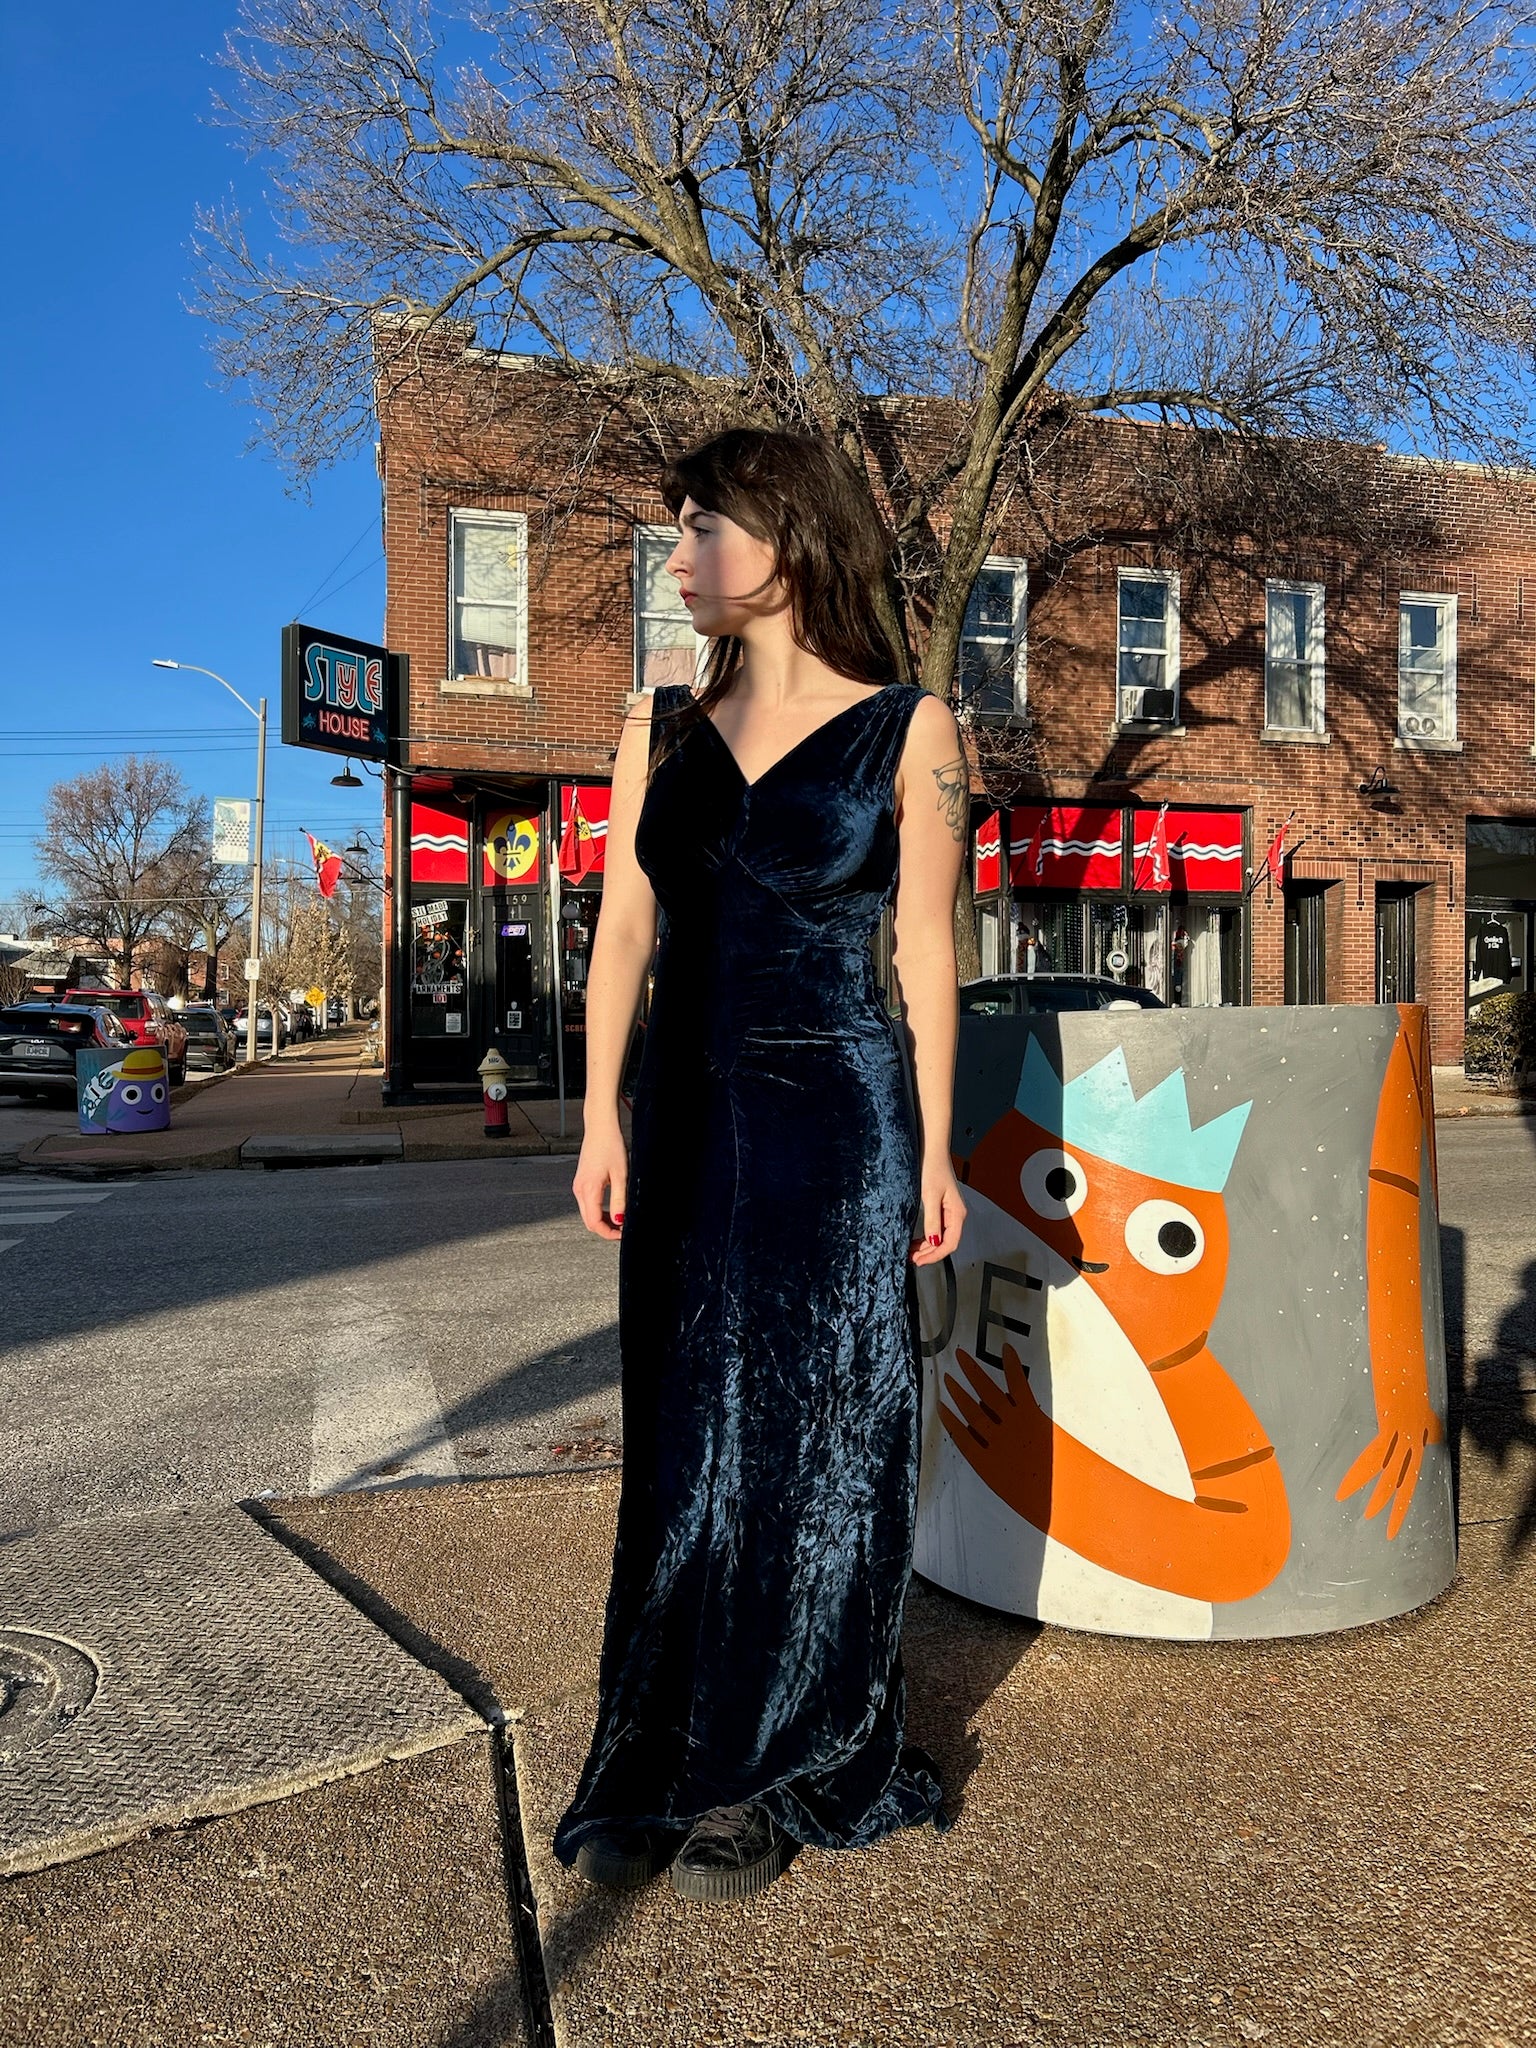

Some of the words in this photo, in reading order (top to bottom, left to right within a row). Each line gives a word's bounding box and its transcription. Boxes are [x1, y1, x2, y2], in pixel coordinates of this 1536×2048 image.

[319, 710, 371, 741] HOUSE
[426, 901, 448, 913] MADE
[416, 911, 448, 927] HOLIDAY
